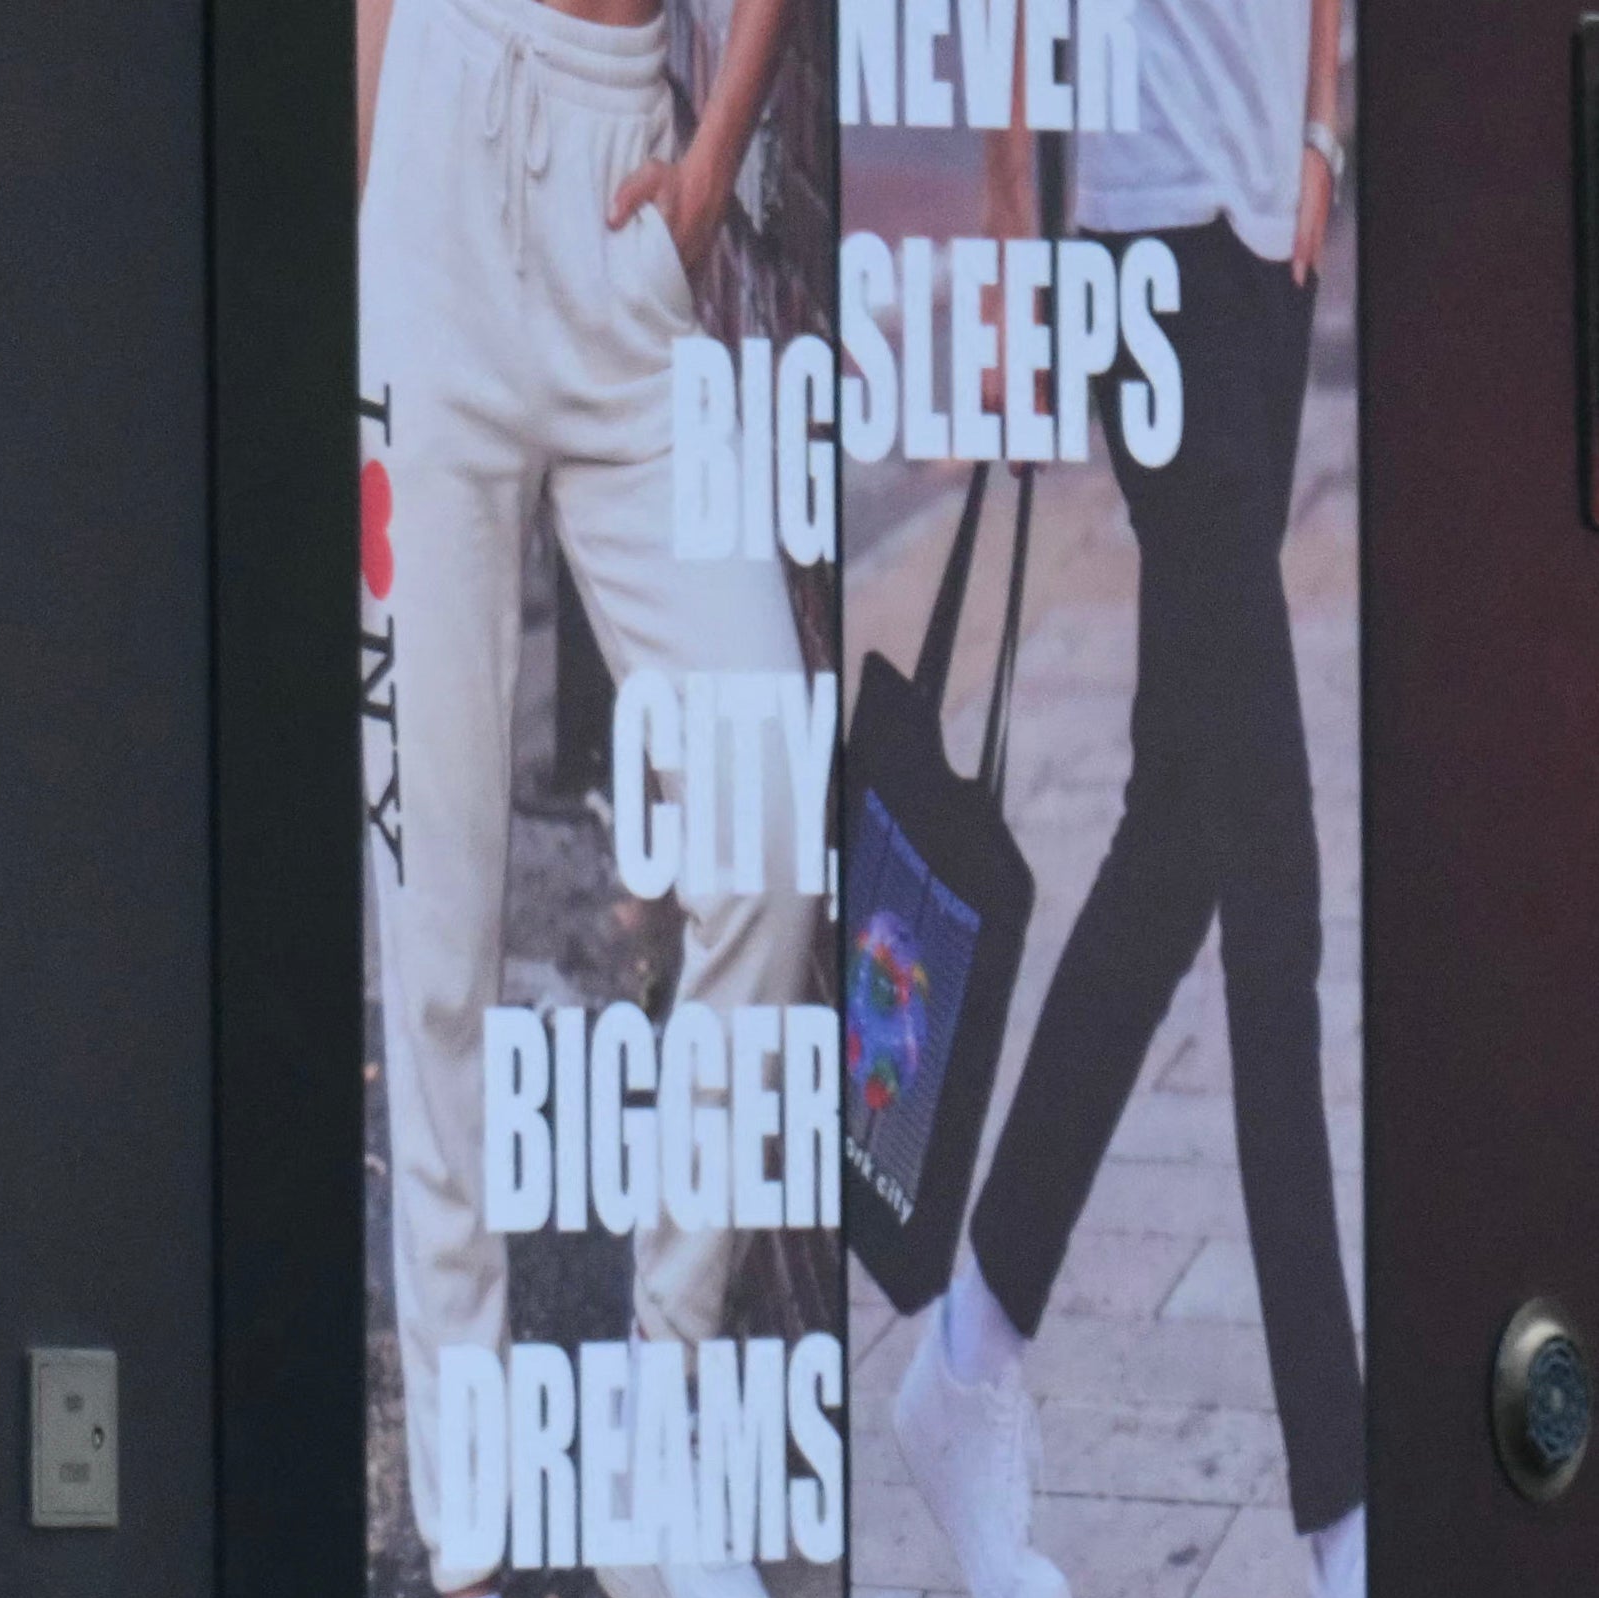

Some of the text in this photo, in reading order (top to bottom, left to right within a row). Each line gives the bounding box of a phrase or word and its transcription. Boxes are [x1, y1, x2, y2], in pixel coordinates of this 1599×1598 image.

[840, 0, 1139, 132] NEVER
[671, 335, 834, 565] BIG
[840, 231, 1185, 470] SLEEPS
[484, 1003, 841, 1233] BIGGER
[440, 1333, 843, 1571] DREAMS
